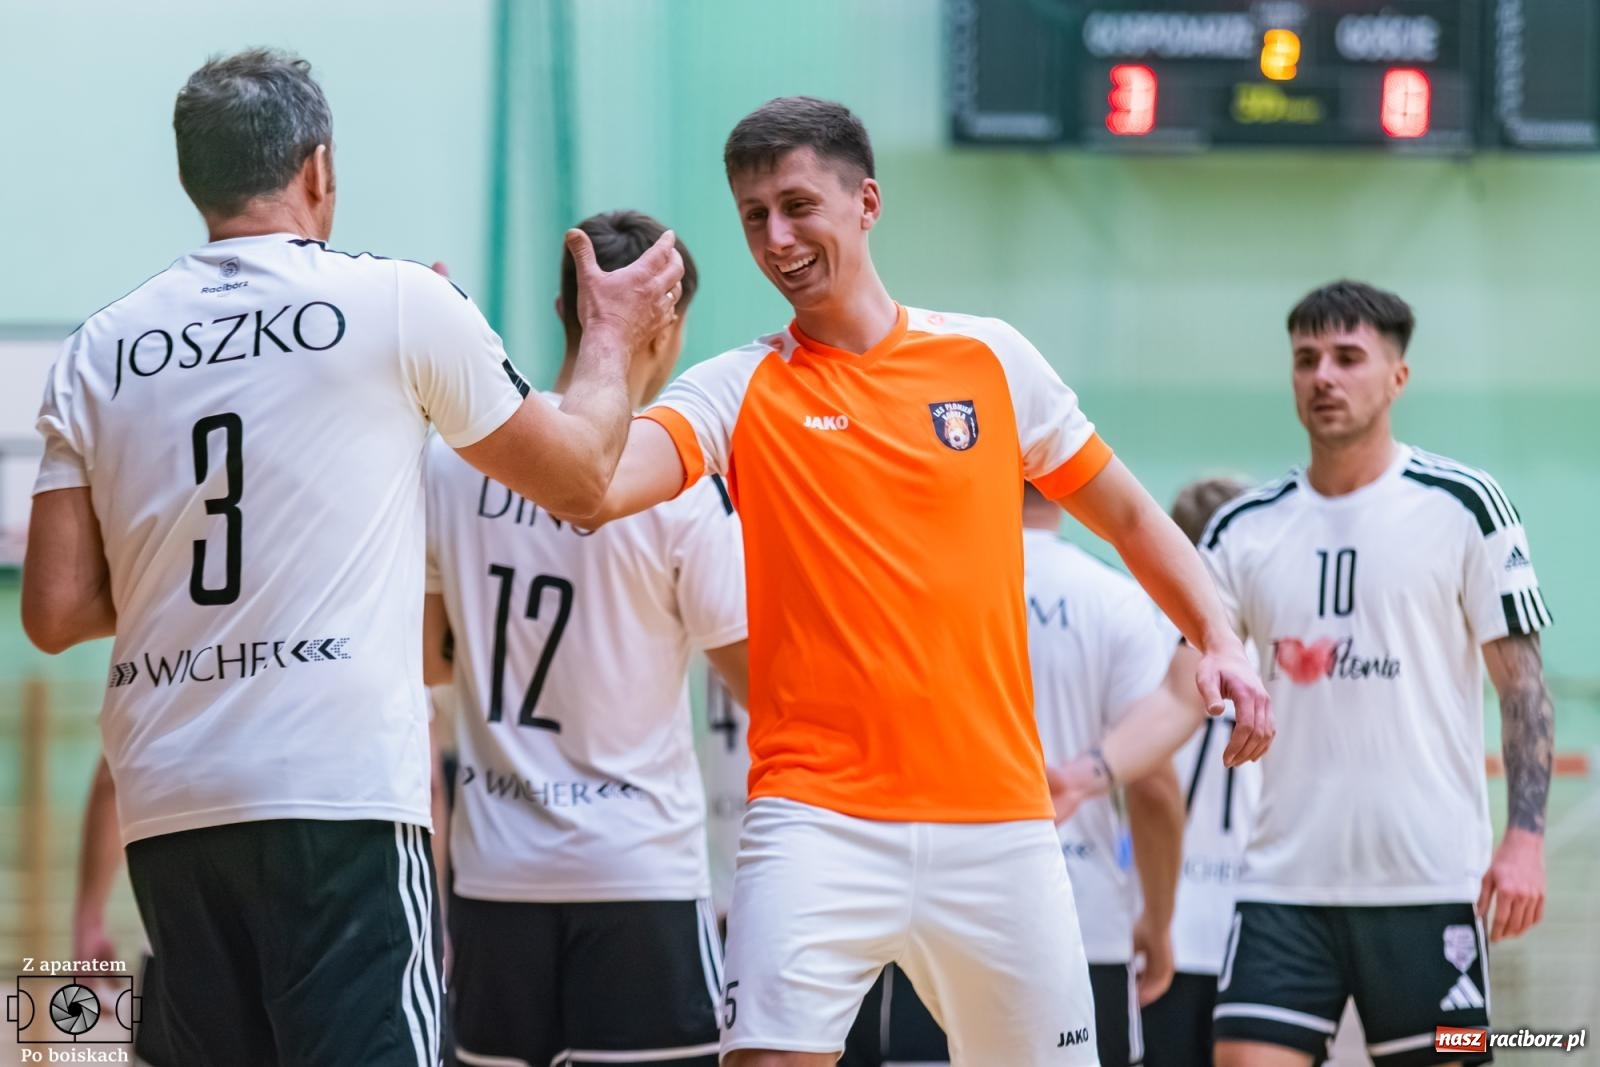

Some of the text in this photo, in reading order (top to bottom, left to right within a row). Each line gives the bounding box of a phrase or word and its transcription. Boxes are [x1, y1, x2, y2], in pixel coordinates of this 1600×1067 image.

[1106, 64, 1157, 135] 3
[200, 281, 249, 294] Racibórz
[111, 301, 346, 401] JOSZKO
[803, 415, 849, 431] JAKO
[190, 412, 243, 606] 3
[1315, 547, 1356, 619] 10
[487, 563, 574, 734] 12
[1056, 1027, 1089, 1048] JAKO
